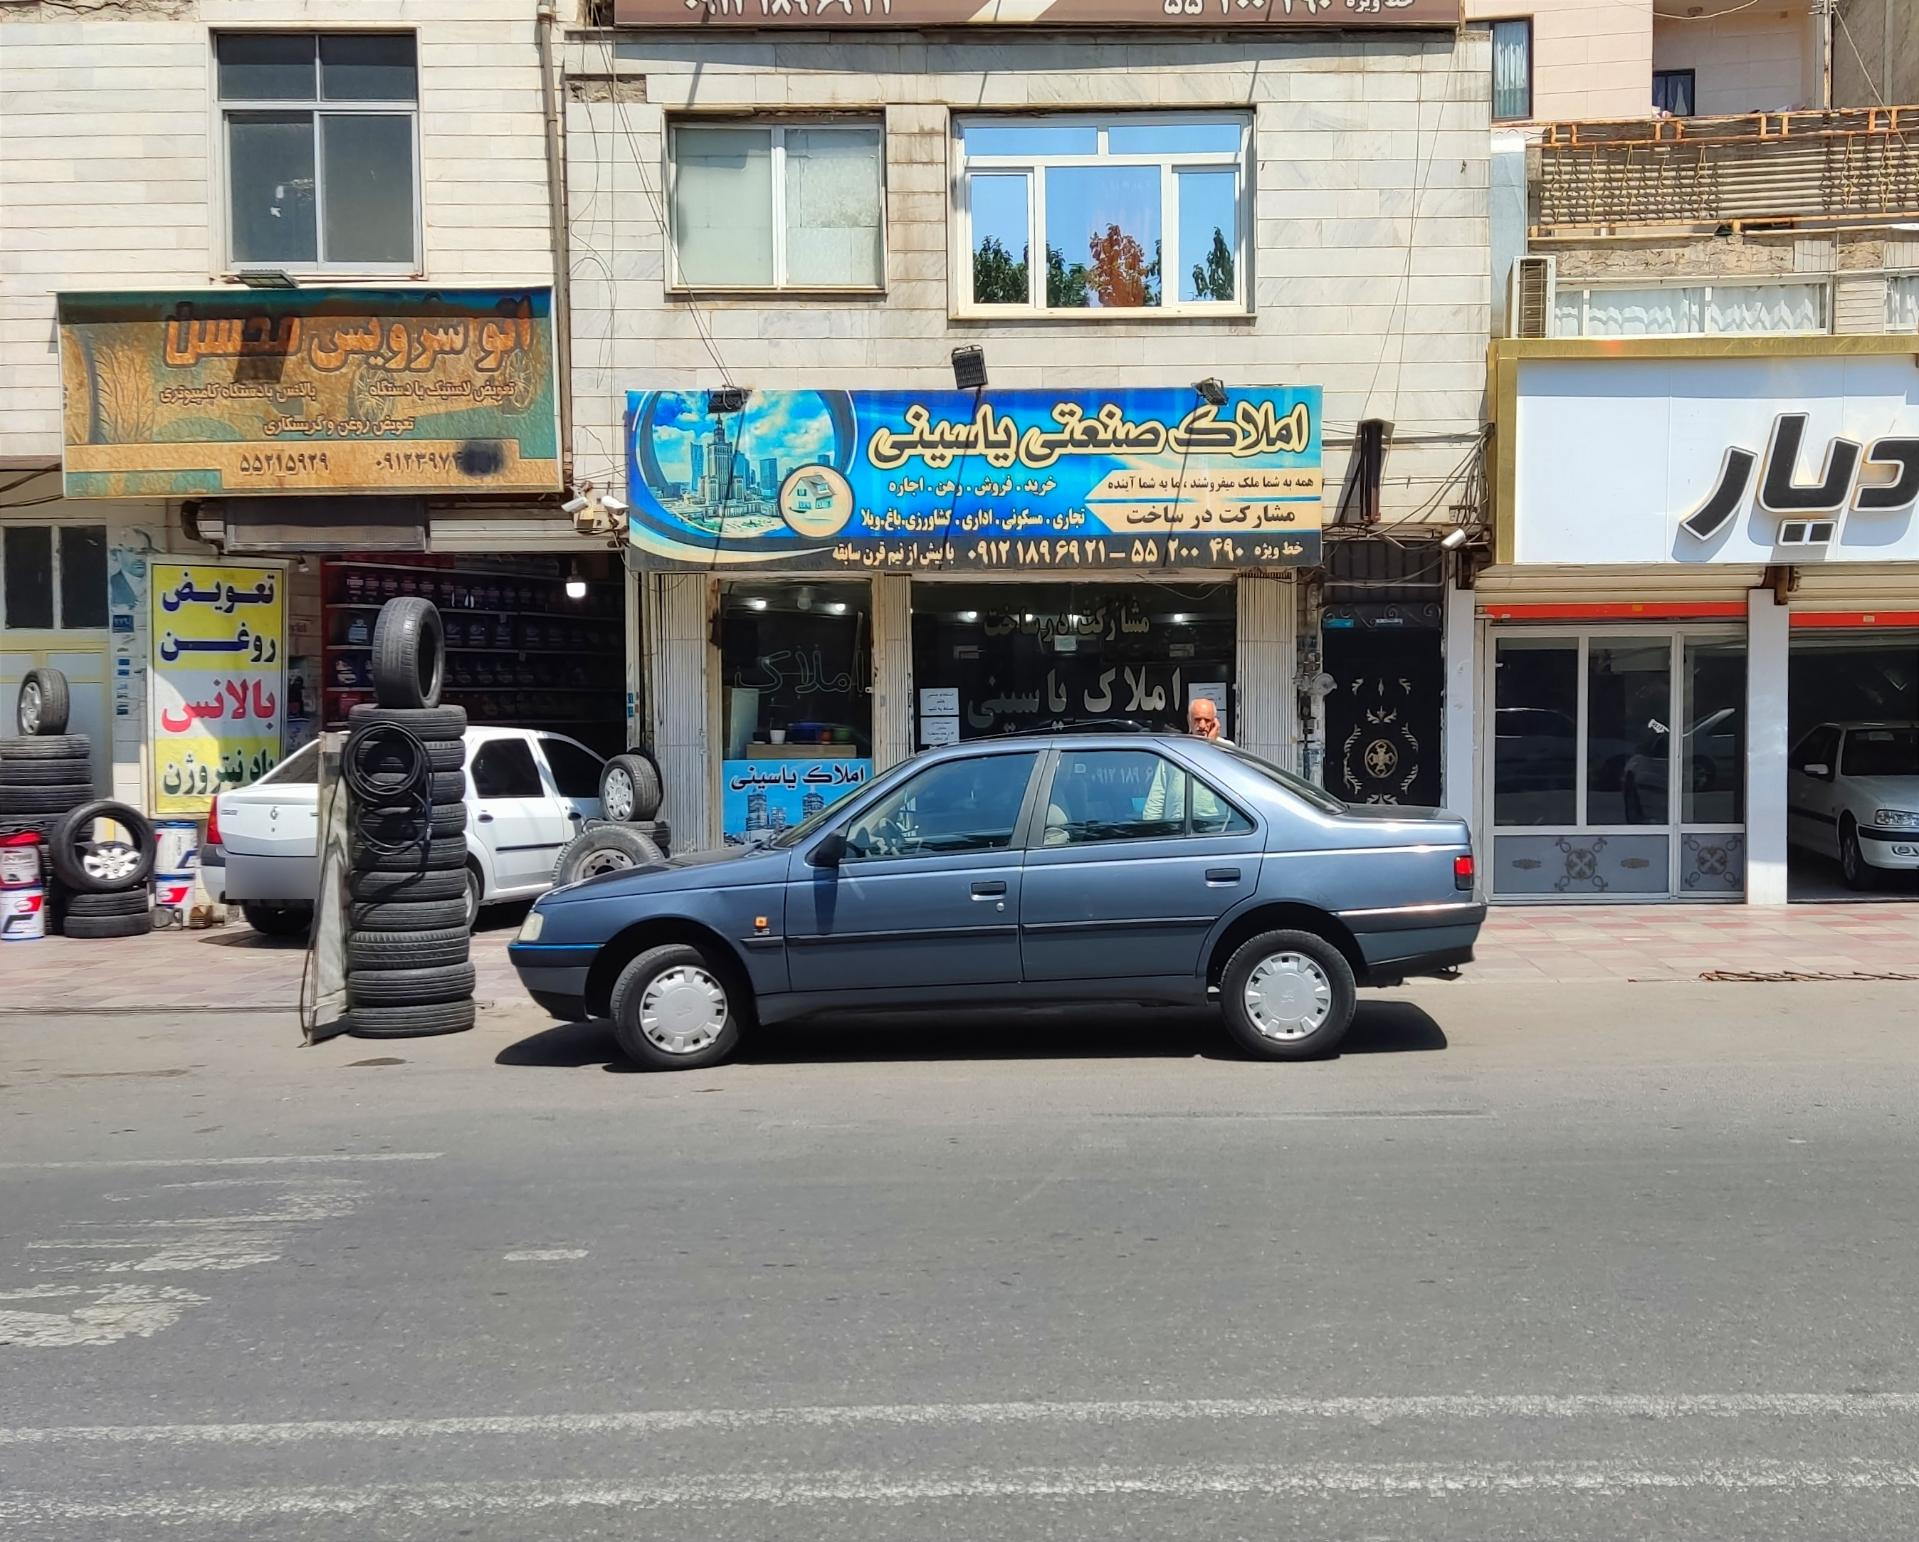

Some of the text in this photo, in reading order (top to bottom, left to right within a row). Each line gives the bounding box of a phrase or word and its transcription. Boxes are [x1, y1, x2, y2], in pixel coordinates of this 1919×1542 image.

[309, 313, 468, 373] سرویس
[160, 383, 220, 406] کامپیوتری
[276, 381, 318, 402] بالانس
[369, 380, 413, 397] دستگاه
[426, 380, 471, 399] لاستیک
[473, 380, 516, 403] تعویض
[338, 416, 370, 437] روغن
[373, 416, 416, 437] تعویض
[868, 400, 1310, 469] املاک صنعتی یاسینی
[888, 476, 924, 496] اجاره
[935, 480, 963, 496] رهن
[974, 476, 1013, 496] فروش
[1024, 477, 1057, 495] خرید
[1108, 475, 1136, 491] آینده
[1139, 477, 1156, 489] شما
[1159, 478, 1169, 491] به
[1171, 477, 1181, 489] ما
[1238, 475, 1260, 488] ملک
[1263, 475, 1280, 488] شما
[1282, 476, 1292, 490] به
[1294, 477, 1314, 489] همه
[1681, 411, 1919, 546] دیار
[961, 508, 993, 531] اداری
[1002, 508, 1043, 531] مسکونی
[1052, 508, 1086, 531] تجاری
[1126, 502, 1296, 529] مشارکت در ساخت
[832, 541, 861, 565] سابقه
[863, 540, 886, 566] قرن
[888, 541, 905, 565] نیم
[906, 541, 918, 565] از
[919, 541, 944, 565] بیش
[945, 541, 955, 565] با
[967, 539, 1010, 564] ۰۹۱۲
[1017, 539, 1051, 564] ۱۸۹
[1131, 538, 1158, 563] ۵۵
[1168, 538, 1200, 563] ۲۰۰
[1208, 537, 1244, 563] ۴۹۰
[1254, 542, 1280, 559] ویژه
[1282, 541, 1304, 555] خط
[162, 572, 275, 613] تعویض
[1077, 600, 1151, 641] مشارکت
[160, 622, 276, 663] روغن
[967, 667, 1068, 733] یاسینی
[1083, 665, 1182, 713] املاک
[161, 679, 276, 734] بالانس
[163, 749, 244, 796] نیتروژن
[730, 764, 865, 791] املاک یاسینی
